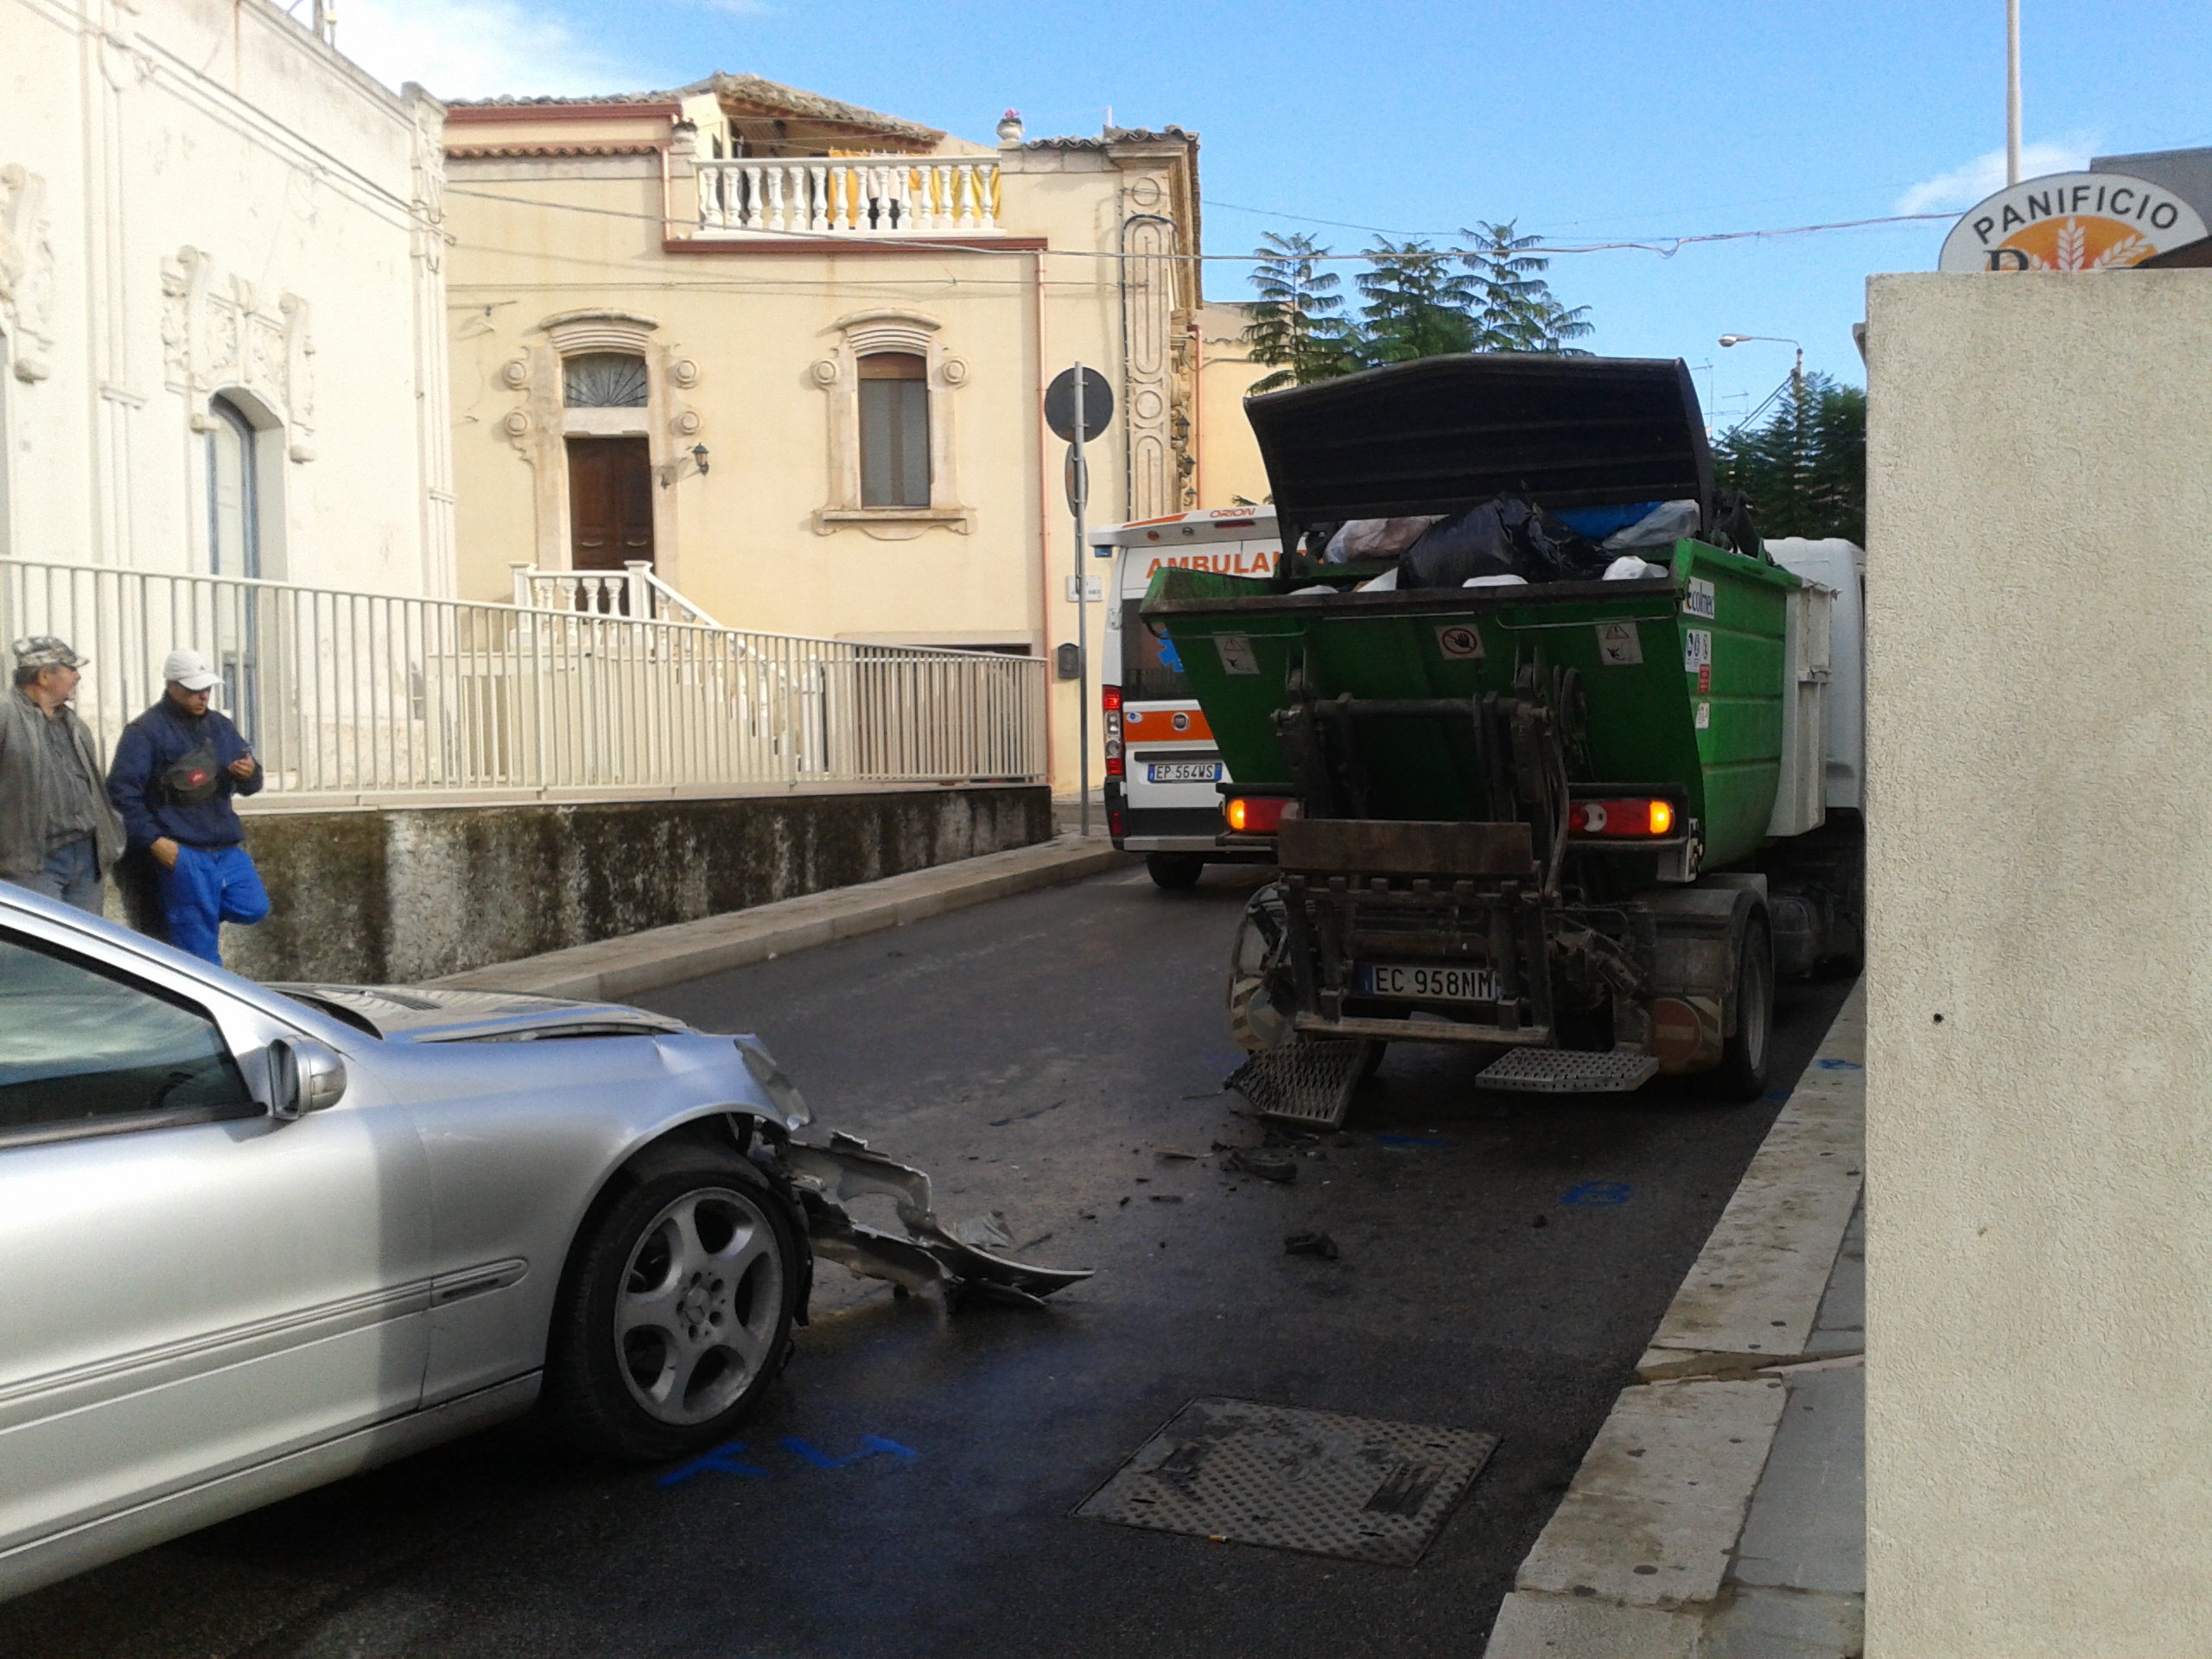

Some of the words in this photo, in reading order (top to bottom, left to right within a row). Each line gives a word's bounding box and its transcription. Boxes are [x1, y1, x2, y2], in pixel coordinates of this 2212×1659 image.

[1973, 186, 2179, 245] PANIFICIO
[1210, 508, 1256, 518] ORION
[1146, 549, 1325, 578] AMBULA
[1376, 967, 1404, 993] EC
